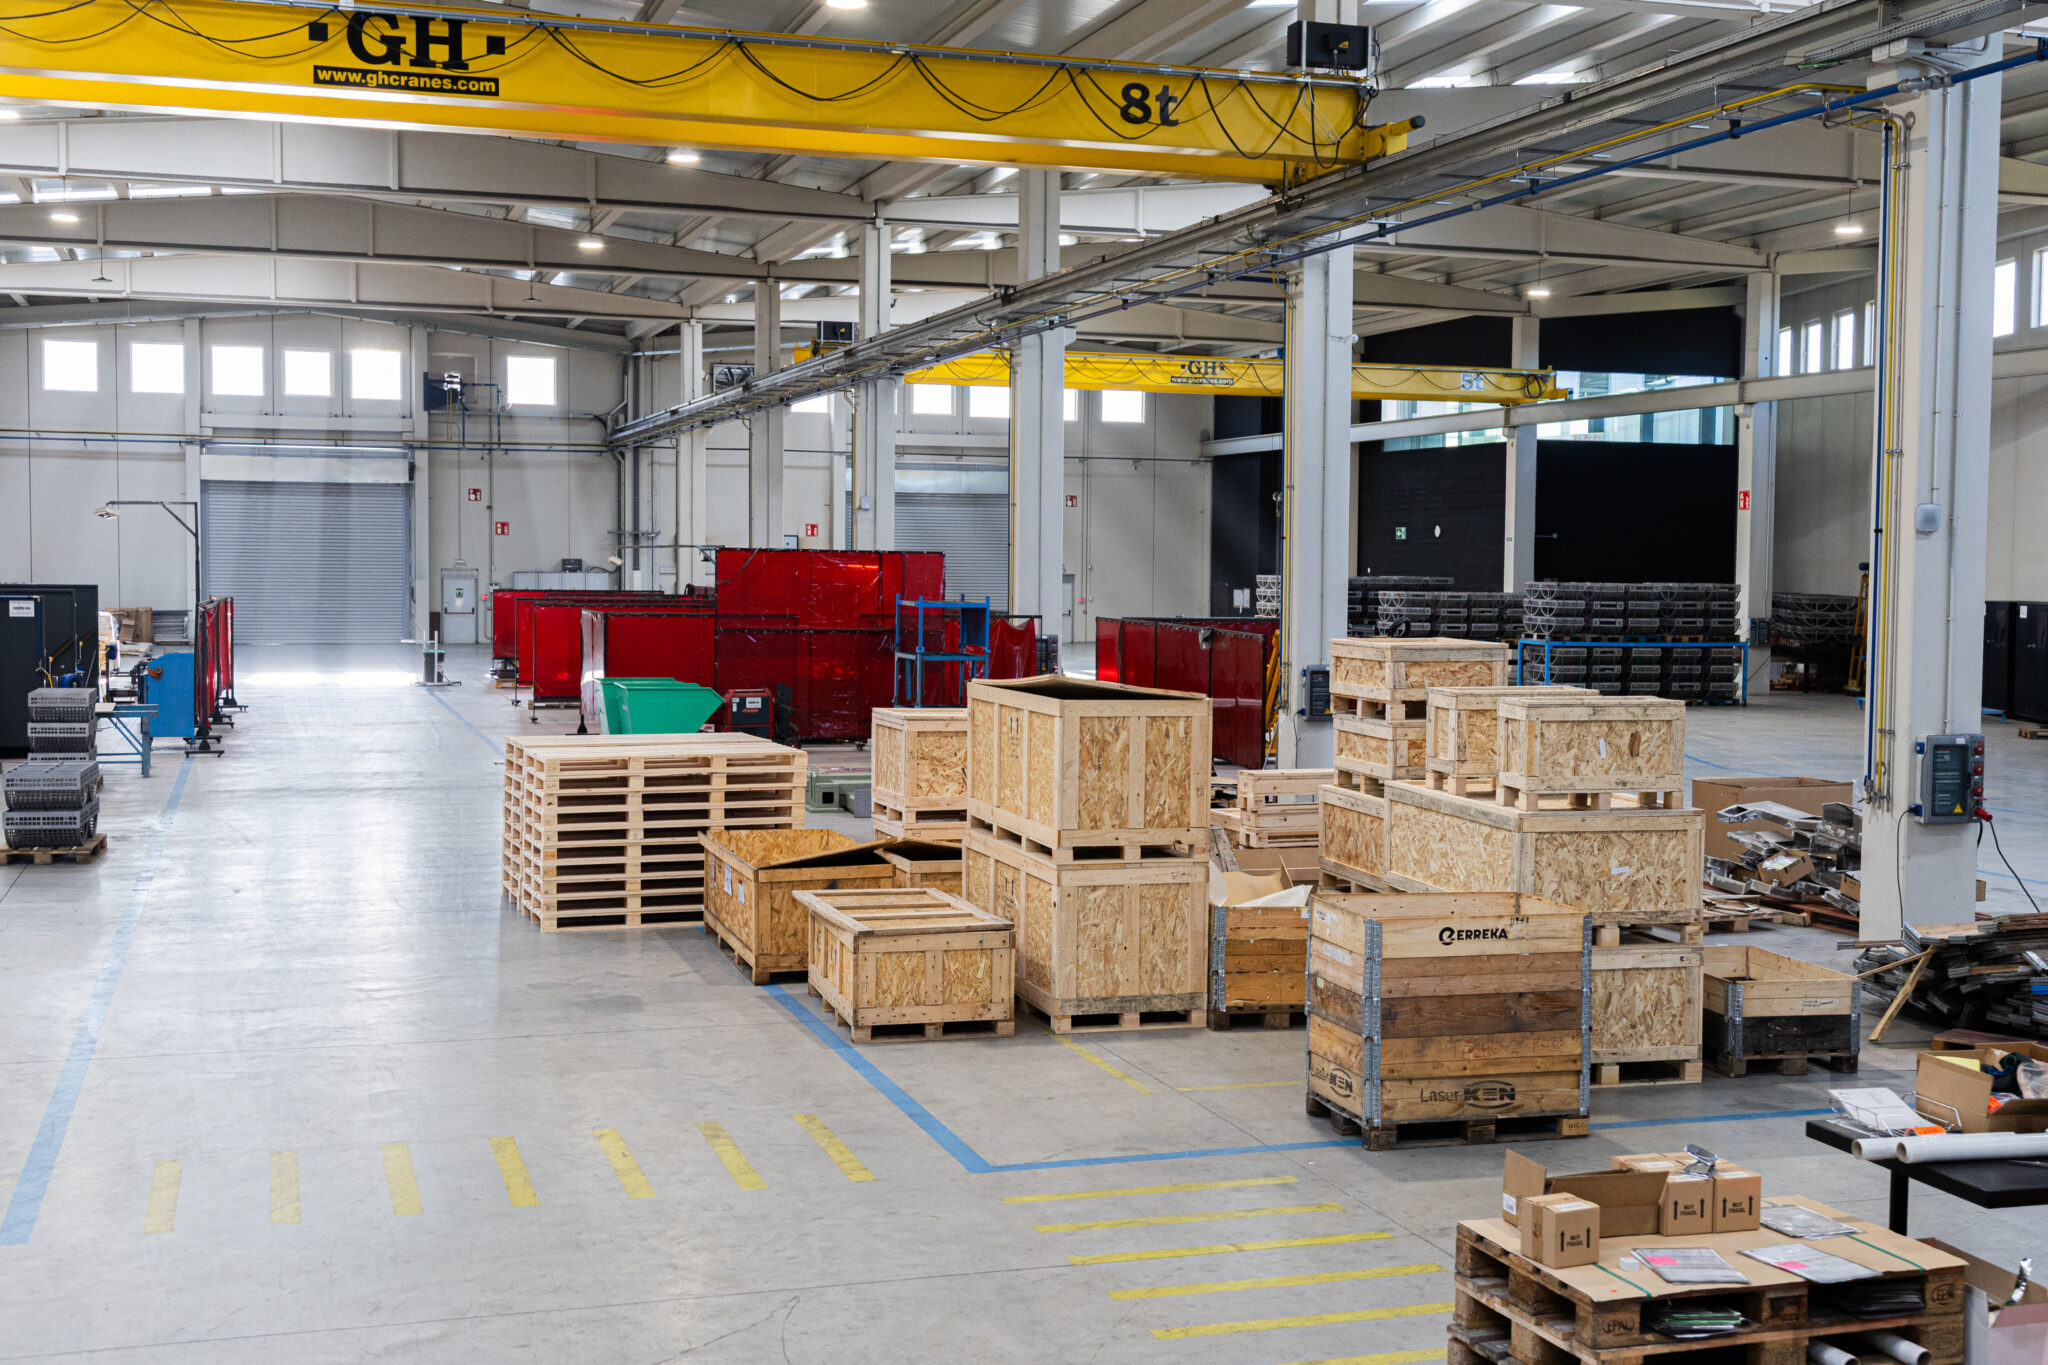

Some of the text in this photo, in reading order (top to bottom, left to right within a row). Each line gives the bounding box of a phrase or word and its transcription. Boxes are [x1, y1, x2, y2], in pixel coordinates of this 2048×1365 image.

[347, 12, 469, 70] GH
[316, 69, 496, 92] www.ghcranes.com
[1120, 83, 1179, 127] 8t
[1188, 361, 1218, 375] GH
[1456, 928, 1509, 941] ERREKA
[1420, 1088, 1460, 1103] Laser
